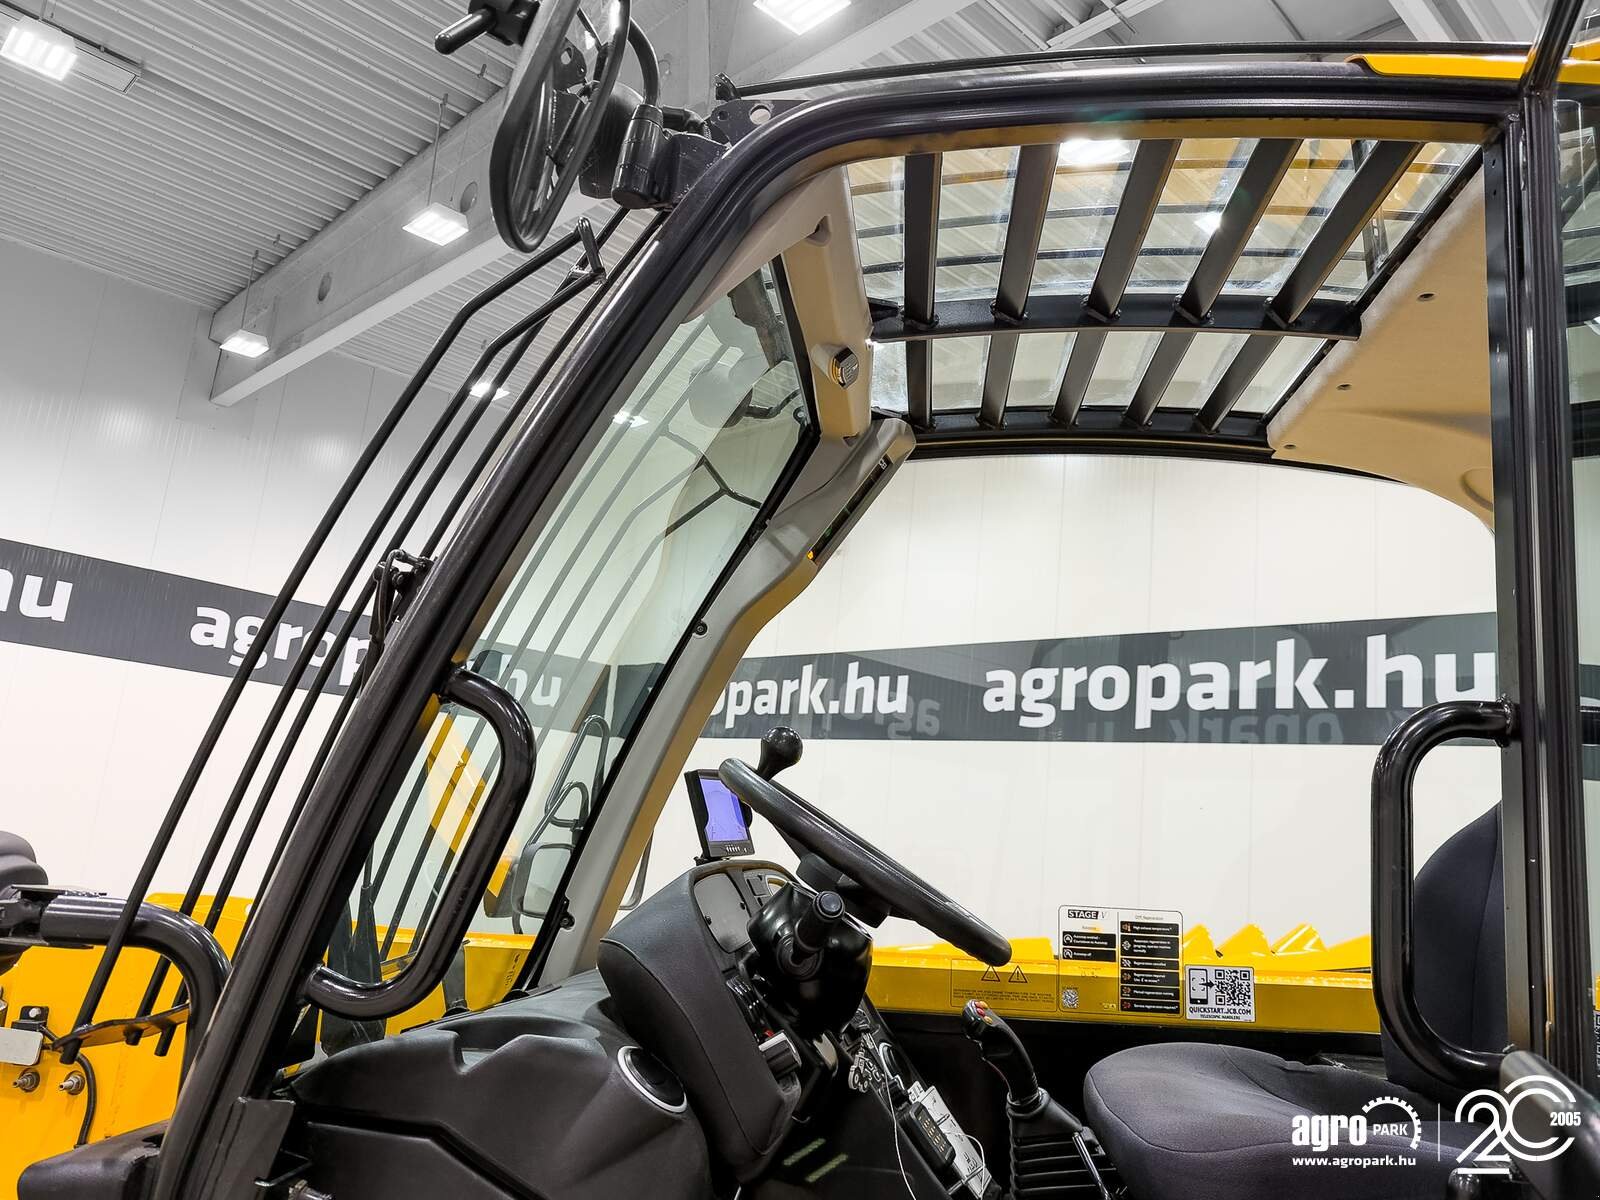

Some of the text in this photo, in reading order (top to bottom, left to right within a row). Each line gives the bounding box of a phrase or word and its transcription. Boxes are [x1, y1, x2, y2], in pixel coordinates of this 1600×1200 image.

[983, 634, 1495, 730] agropark.hu
[1068, 910, 1097, 919] STAGE
[1189, 1006, 1251, 1015] QUICKSTART.JCB.COM
